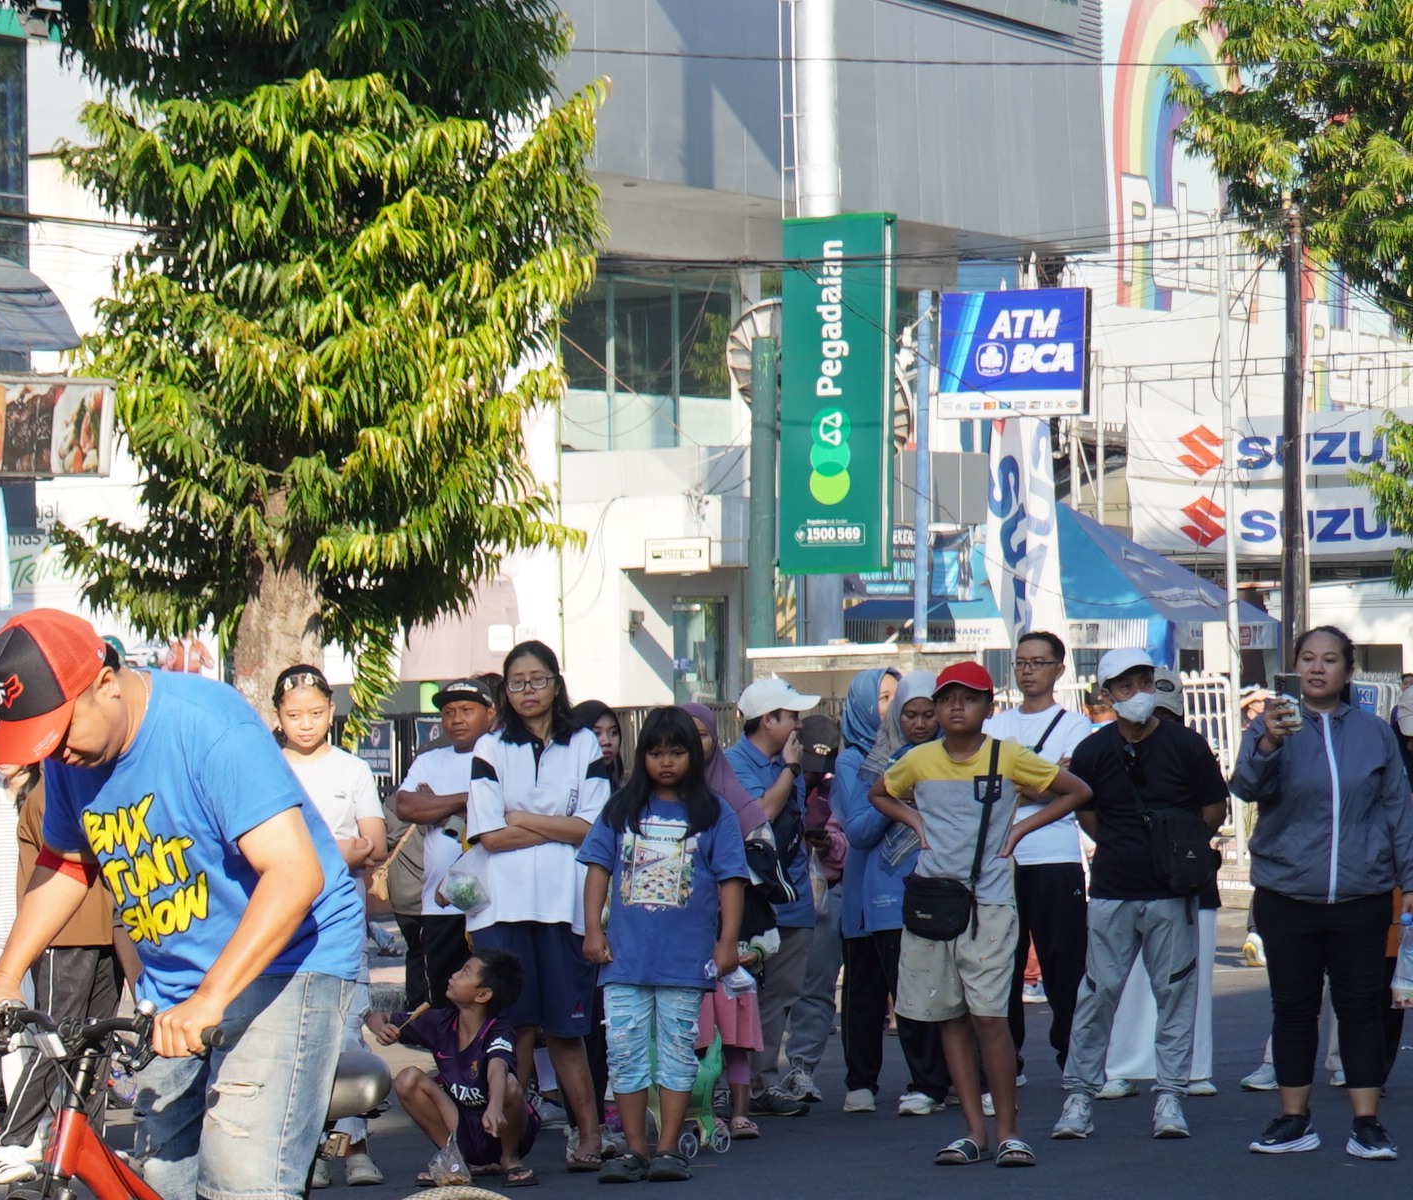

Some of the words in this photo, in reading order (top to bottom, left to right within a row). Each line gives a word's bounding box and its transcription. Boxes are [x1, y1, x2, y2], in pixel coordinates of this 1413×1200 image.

[816, 239, 849, 397] Pegadaian
[987, 308, 1061, 340] ATM
[1009, 342, 1075, 374] BCA
[806, 526, 836, 541] 1500
[837, 526, 861, 540] 569
[944, 627, 992, 636] FINANCE
[82, 793, 155, 857] BMX
[121, 871, 210, 947] SHOW
